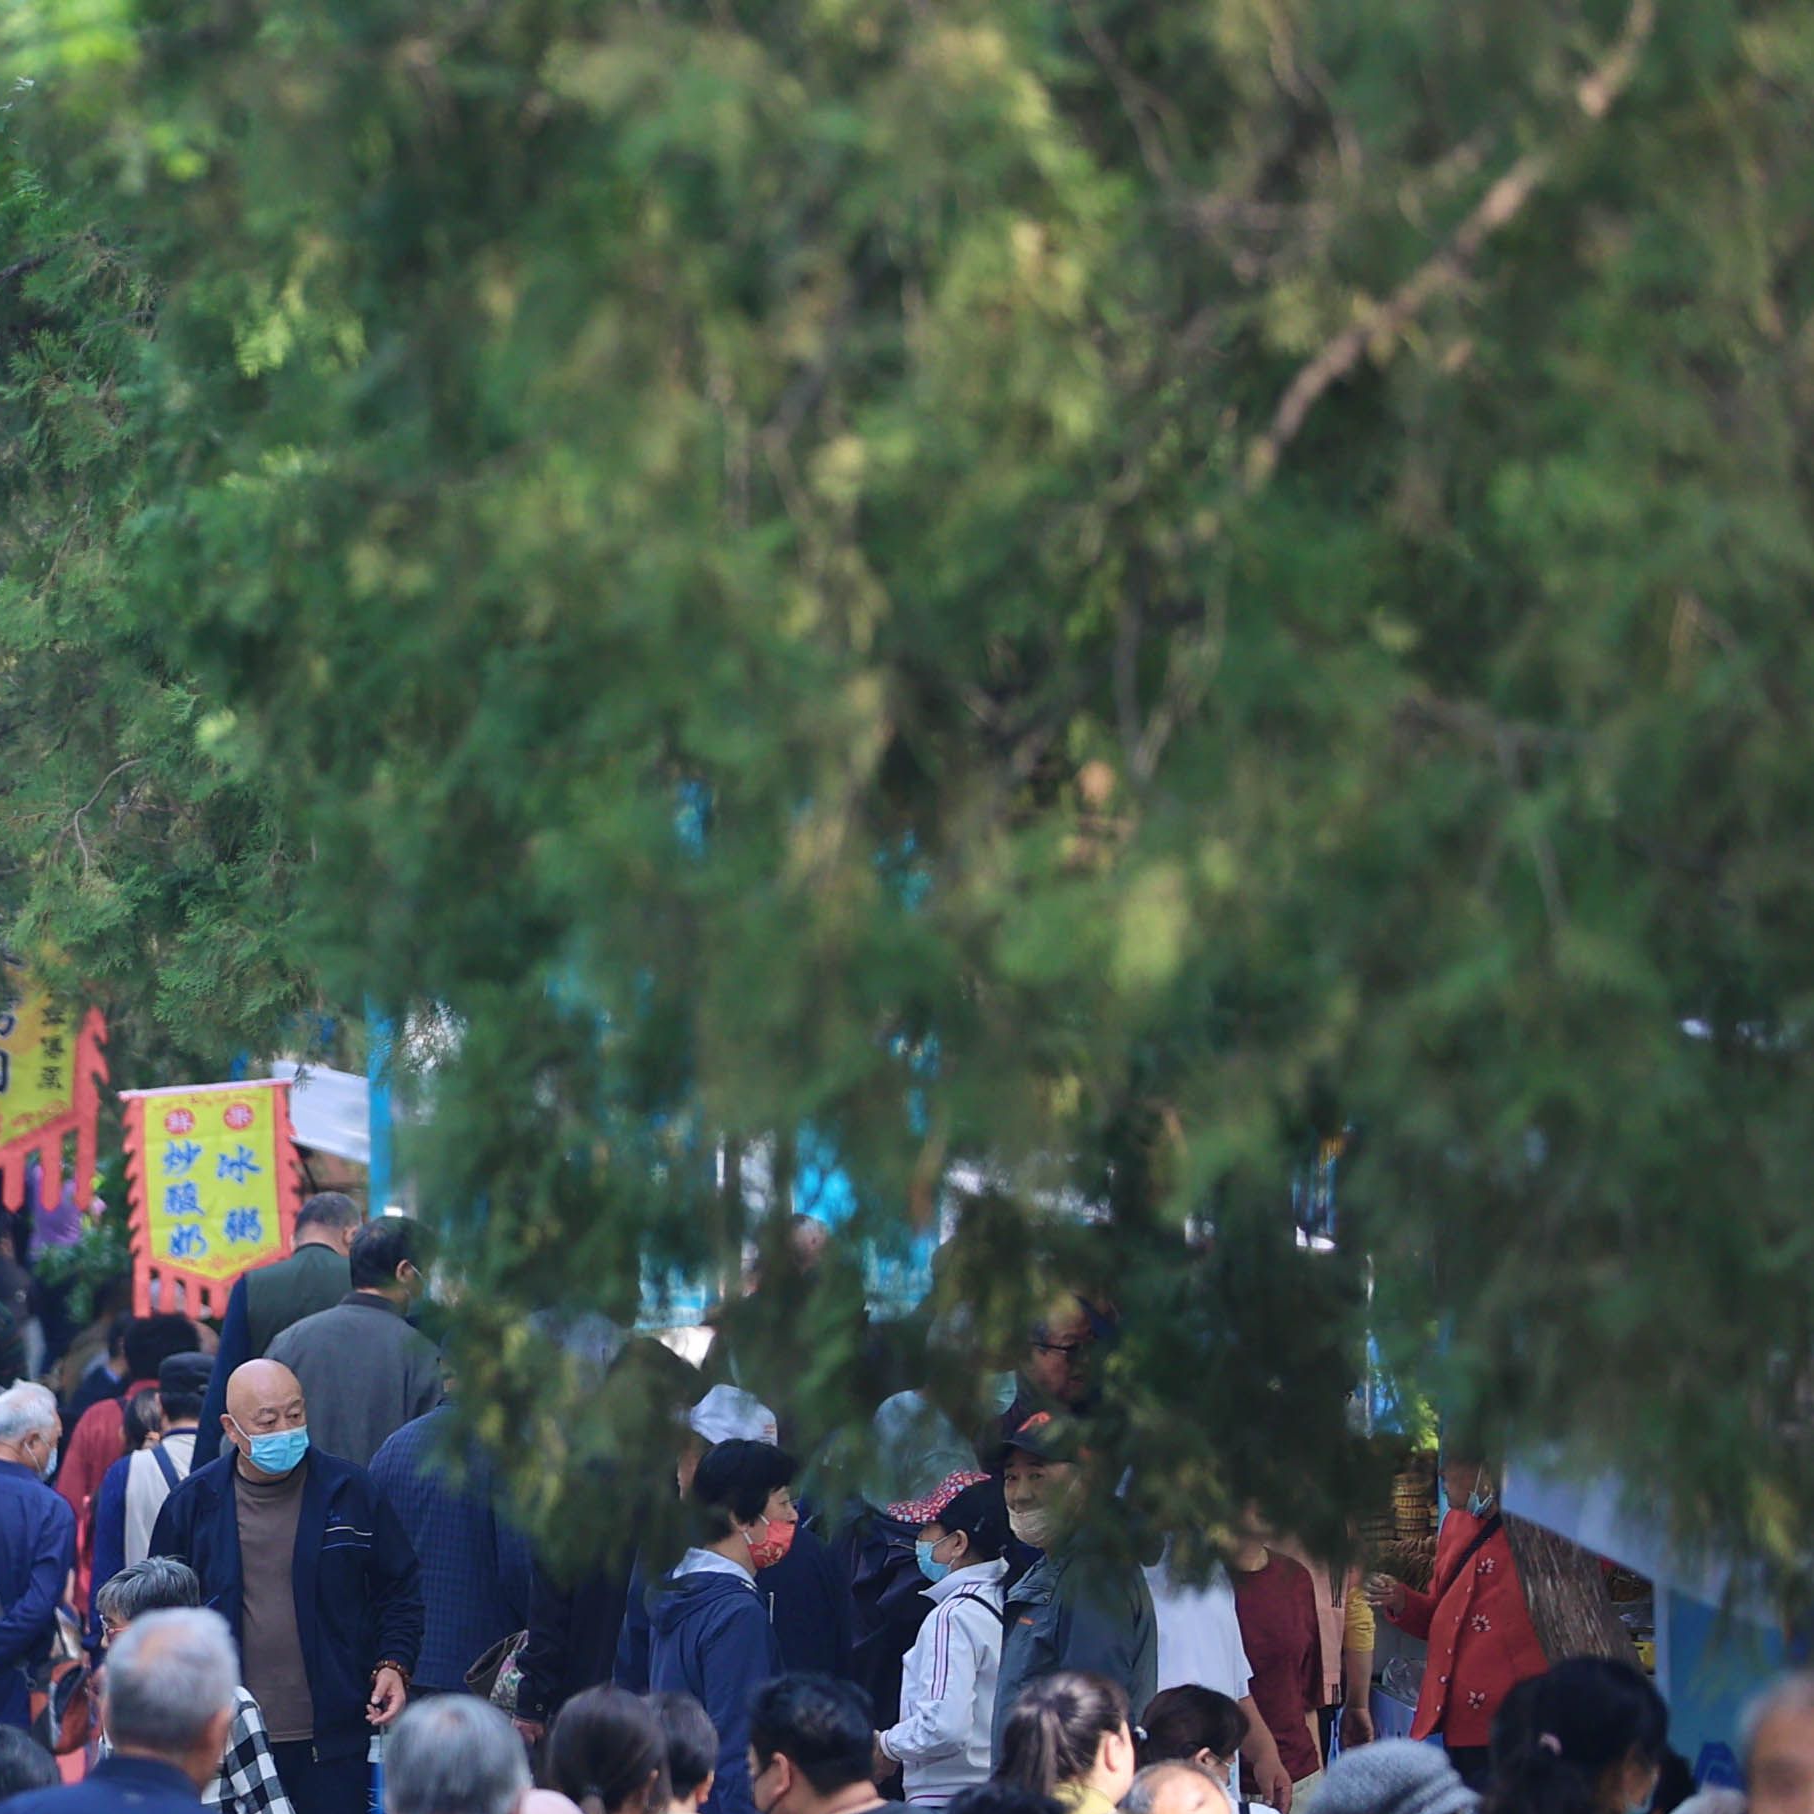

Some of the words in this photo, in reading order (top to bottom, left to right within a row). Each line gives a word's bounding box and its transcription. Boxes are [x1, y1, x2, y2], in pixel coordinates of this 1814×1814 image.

[162, 1139, 208, 1258] 炒酸奶
[215, 1144, 263, 1244] 冰粥
